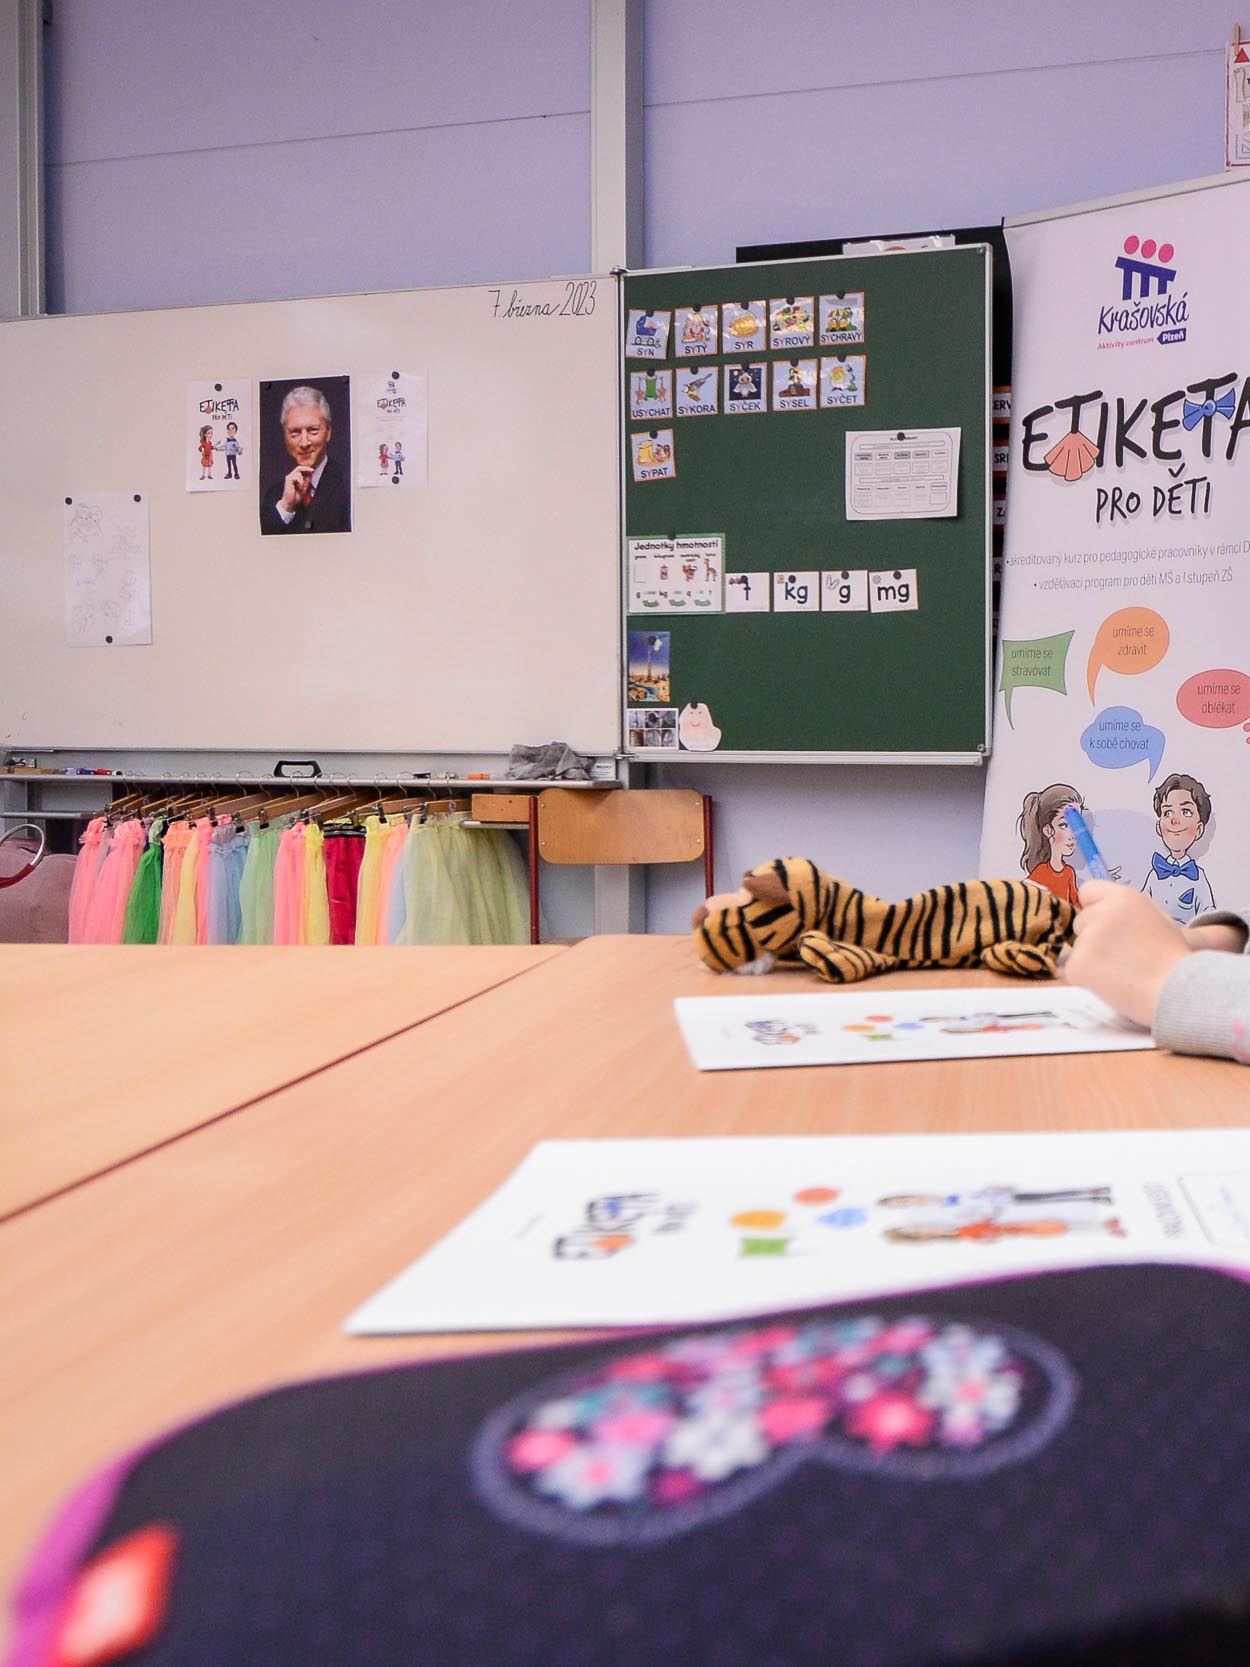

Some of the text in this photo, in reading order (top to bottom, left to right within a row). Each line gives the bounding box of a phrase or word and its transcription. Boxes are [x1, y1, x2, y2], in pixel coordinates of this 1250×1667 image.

[559, 280, 597, 316] 2023
[1098, 292, 1190, 335] Krašovská
[772, 333, 811, 348] SYROVÝ
[820, 331, 862, 344] SYCHRAVÝ
[1097, 331, 1184, 350] Aktivity centrum Plzeň
[636, 347, 655, 357] SYN
[684, 343, 708, 354] SYTÝ
[779, 399, 810, 409] SYSEL
[827, 393, 858, 405] SYČET
[199, 398, 240, 414] ETIKETA
[632, 407, 671, 418] USYCHAT
[641, 467, 668, 479] SYPAT
[1096, 462, 1211, 523] PRO DĚTI
[634, 540, 719, 552] Jednotky hmotnosti
[1084, 553, 1098, 565] pro
[1084, 576, 1121, 592] program
[1123, 576, 1138, 589] pro
[1140, 573, 1157, 586] děti
[1159, 570, 1174, 585] MŠ
[1221, 566, 1233, 582] ZŠ
[741, 577, 751, 601] t
[785, 581, 808, 604] kg
[838, 584, 851, 603] g
[877, 582, 910, 604] mg
[1143, 626, 1155, 637] se
[1042, 647, 1053, 659] se
[1117, 644, 1148, 656] zdravit
[1011, 665, 1051, 677] stravovat
[1230, 684, 1241, 695] se
[1201, 701, 1236, 714] oblékat
[1130, 721, 1142, 732] se
[1089, 737, 1150, 750] k sobě chovat
